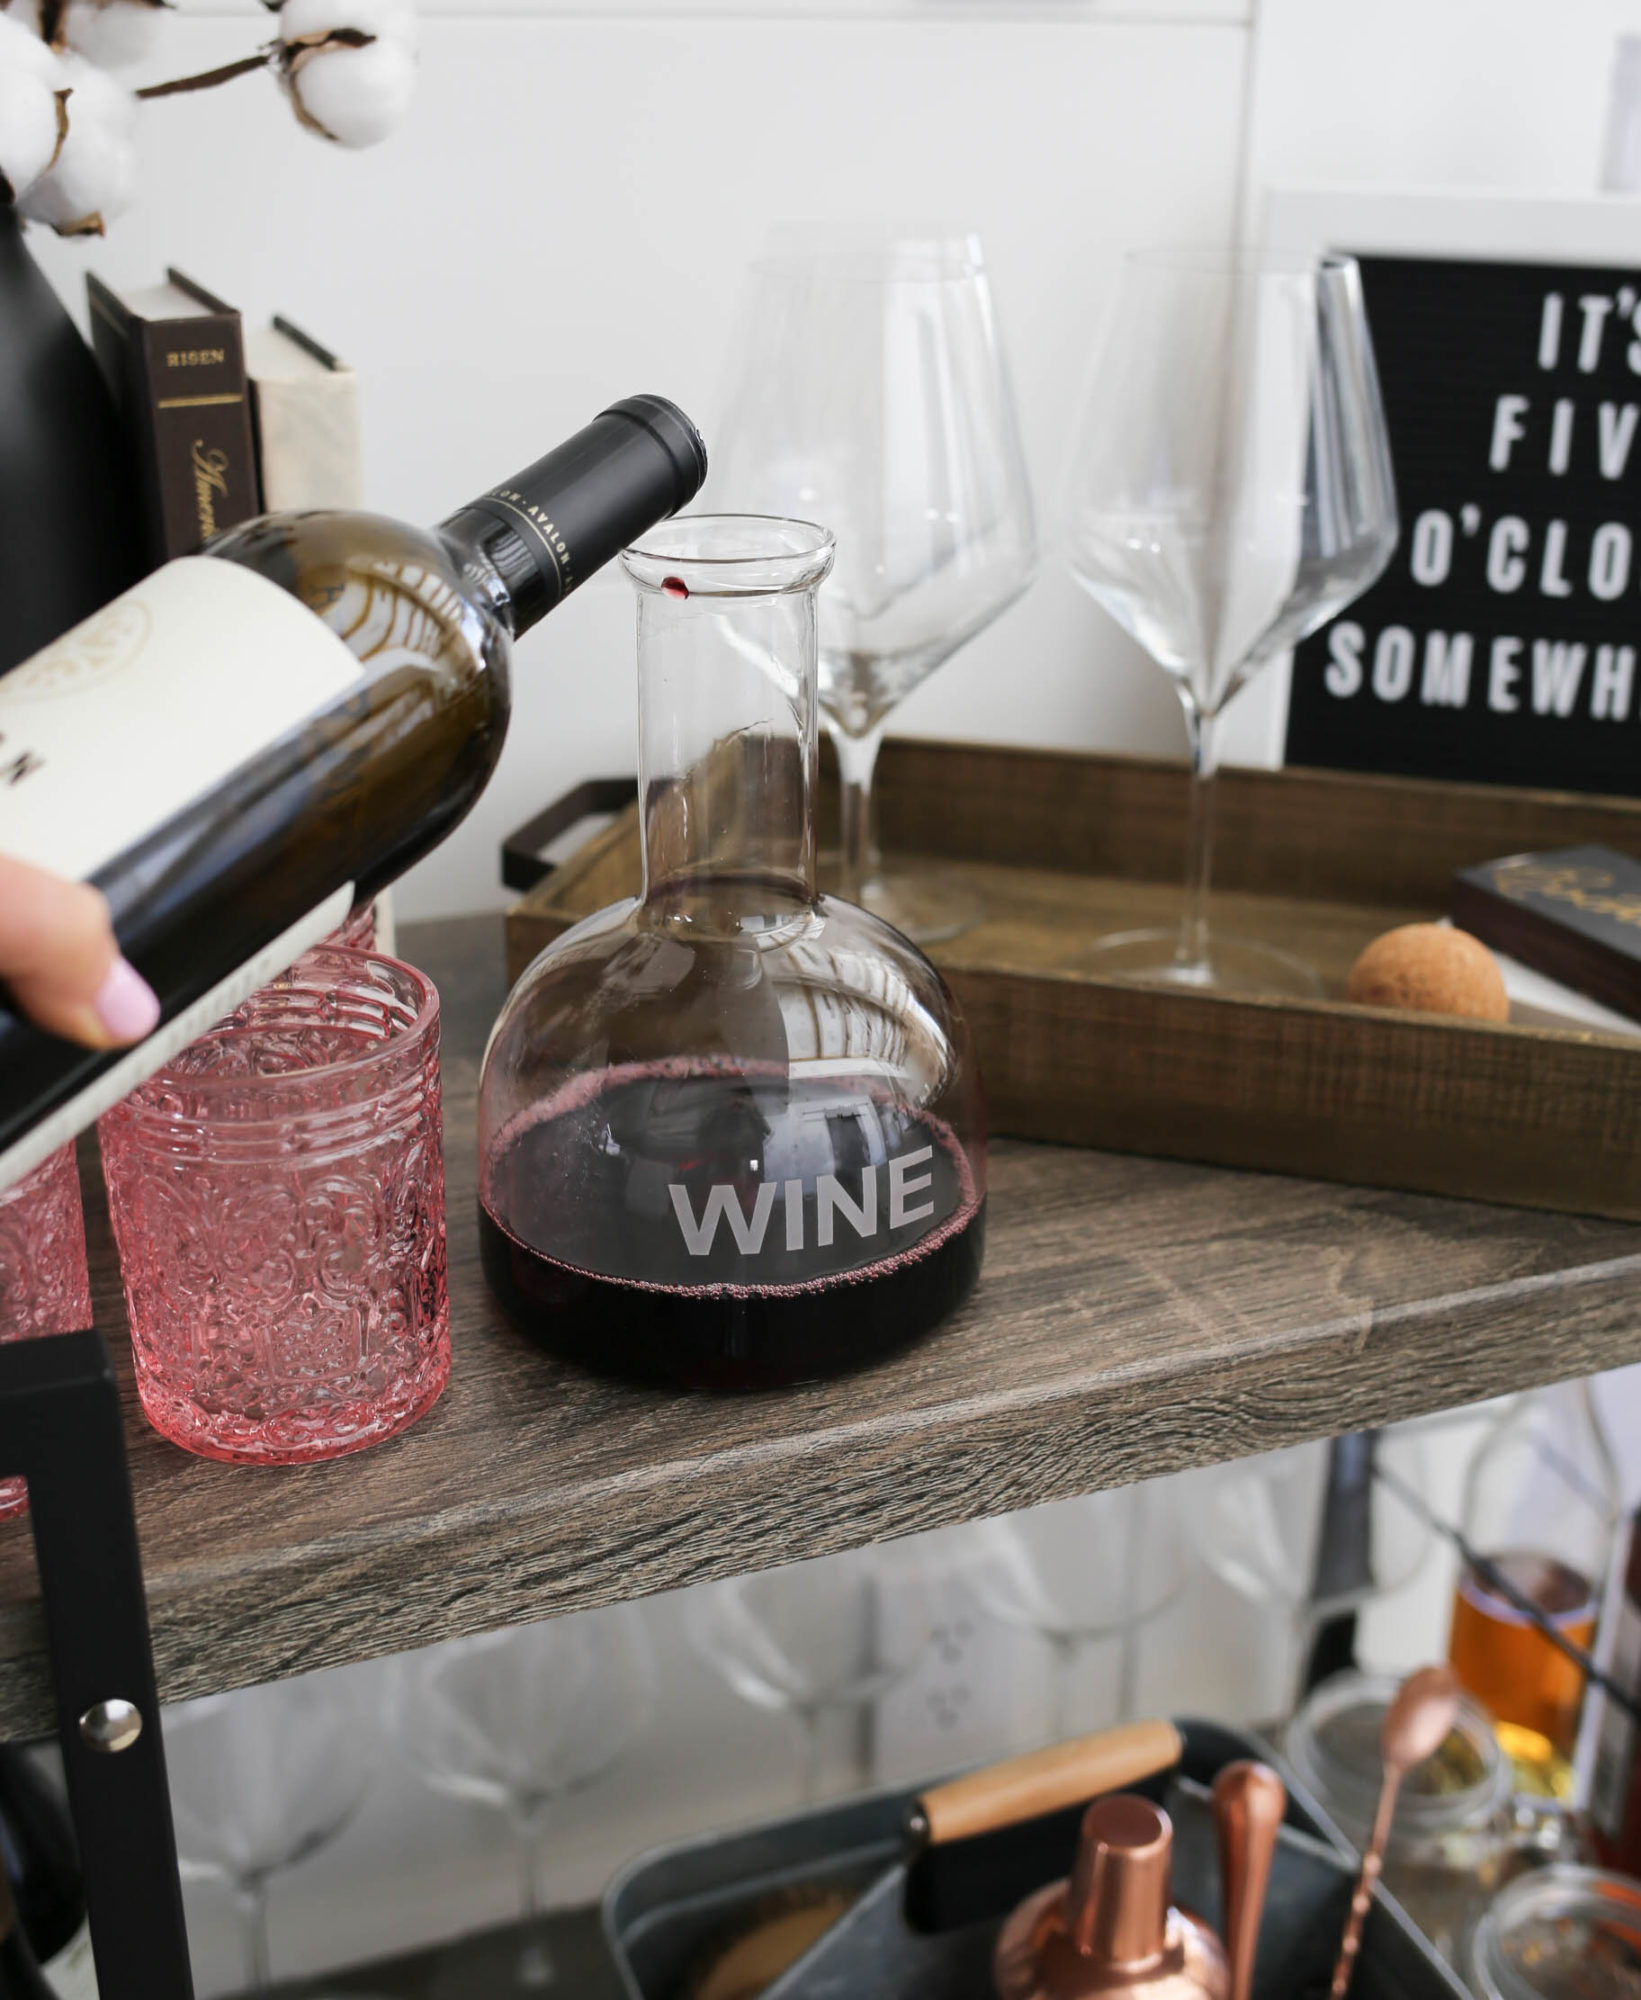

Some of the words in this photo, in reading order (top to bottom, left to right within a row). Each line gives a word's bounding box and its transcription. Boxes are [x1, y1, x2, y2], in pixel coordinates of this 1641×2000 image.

[167, 349, 225, 367] RISEN
[1488, 395, 1639, 481] FIV
[527, 505, 571, 565] AVALON
[1410, 504, 1632, 600] O'CLO
[1325, 621, 1636, 721] SOMEWH
[668, 1144, 934, 1256] WINE
